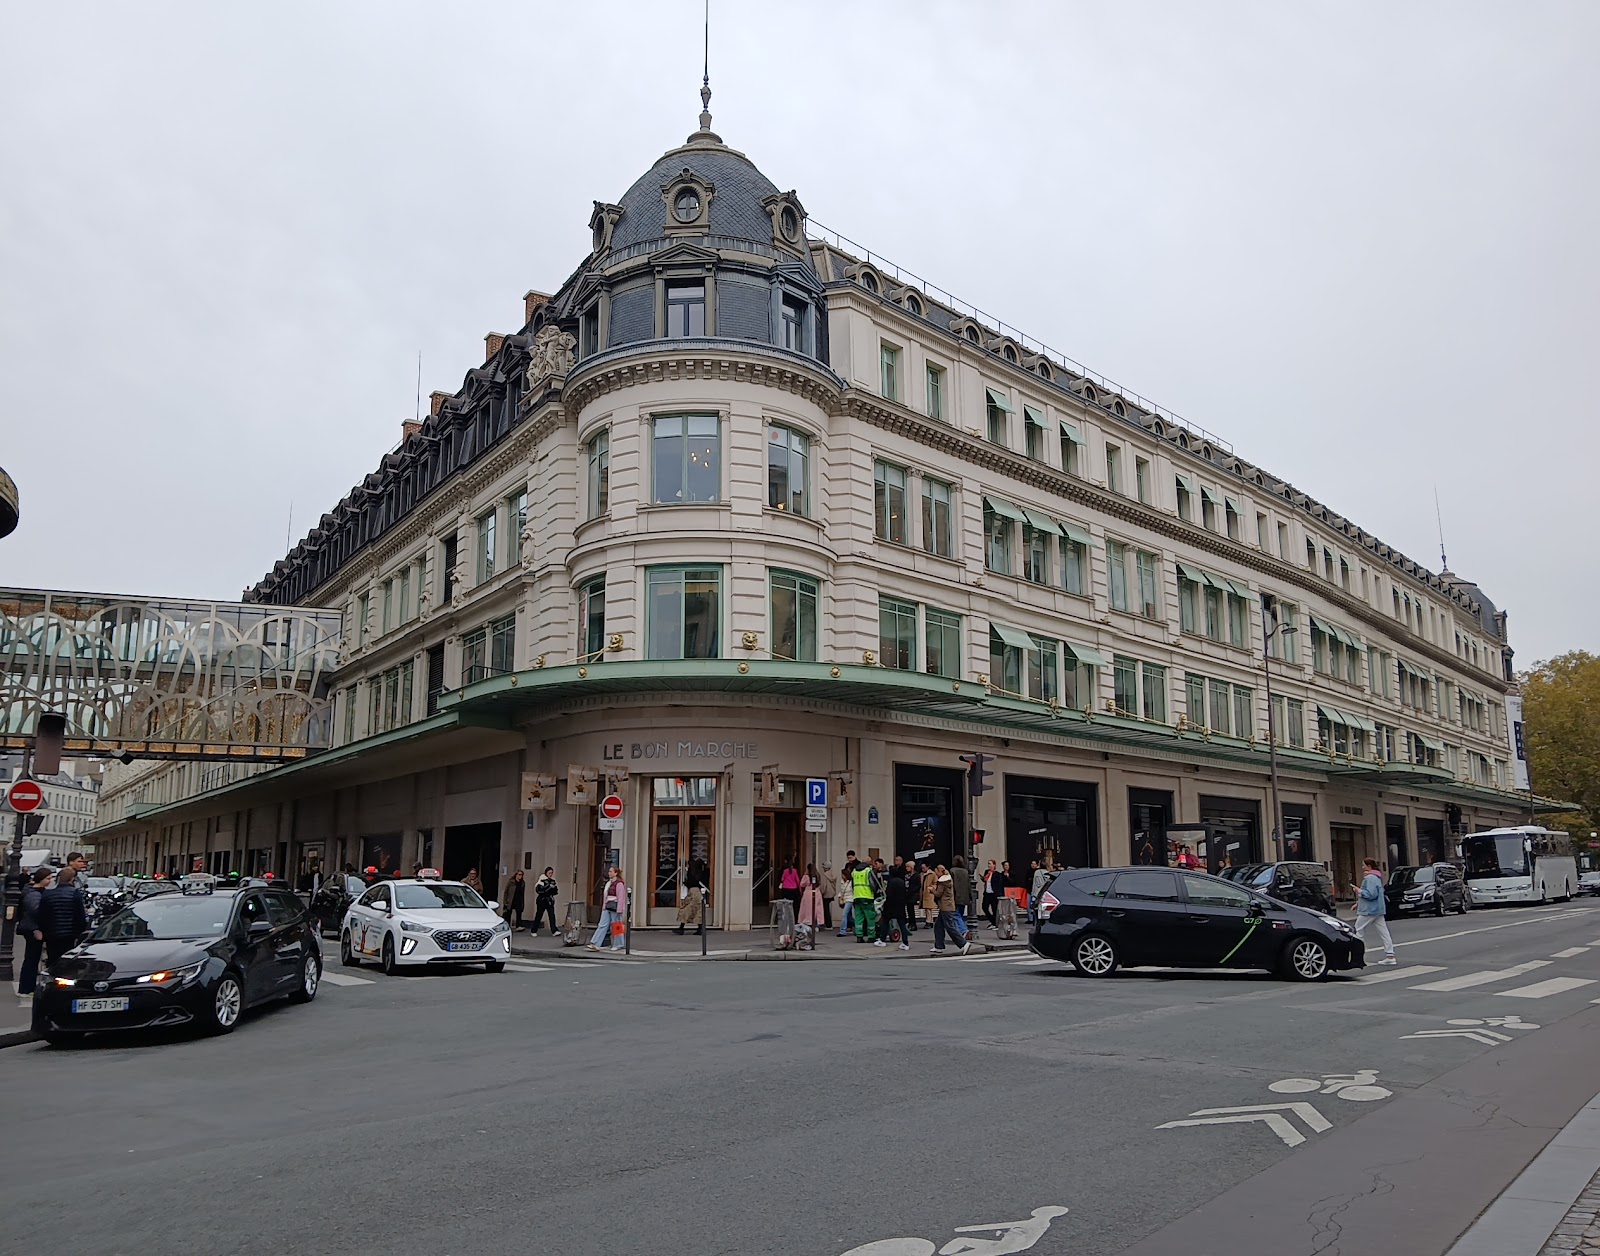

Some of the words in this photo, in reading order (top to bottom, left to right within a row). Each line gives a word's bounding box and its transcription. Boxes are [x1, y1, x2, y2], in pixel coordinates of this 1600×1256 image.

[603, 744, 624, 760] LE
[630, 742, 668, 759] BON
[677, 741, 758, 759] MARCHE
[813, 784, 822, 801] P
